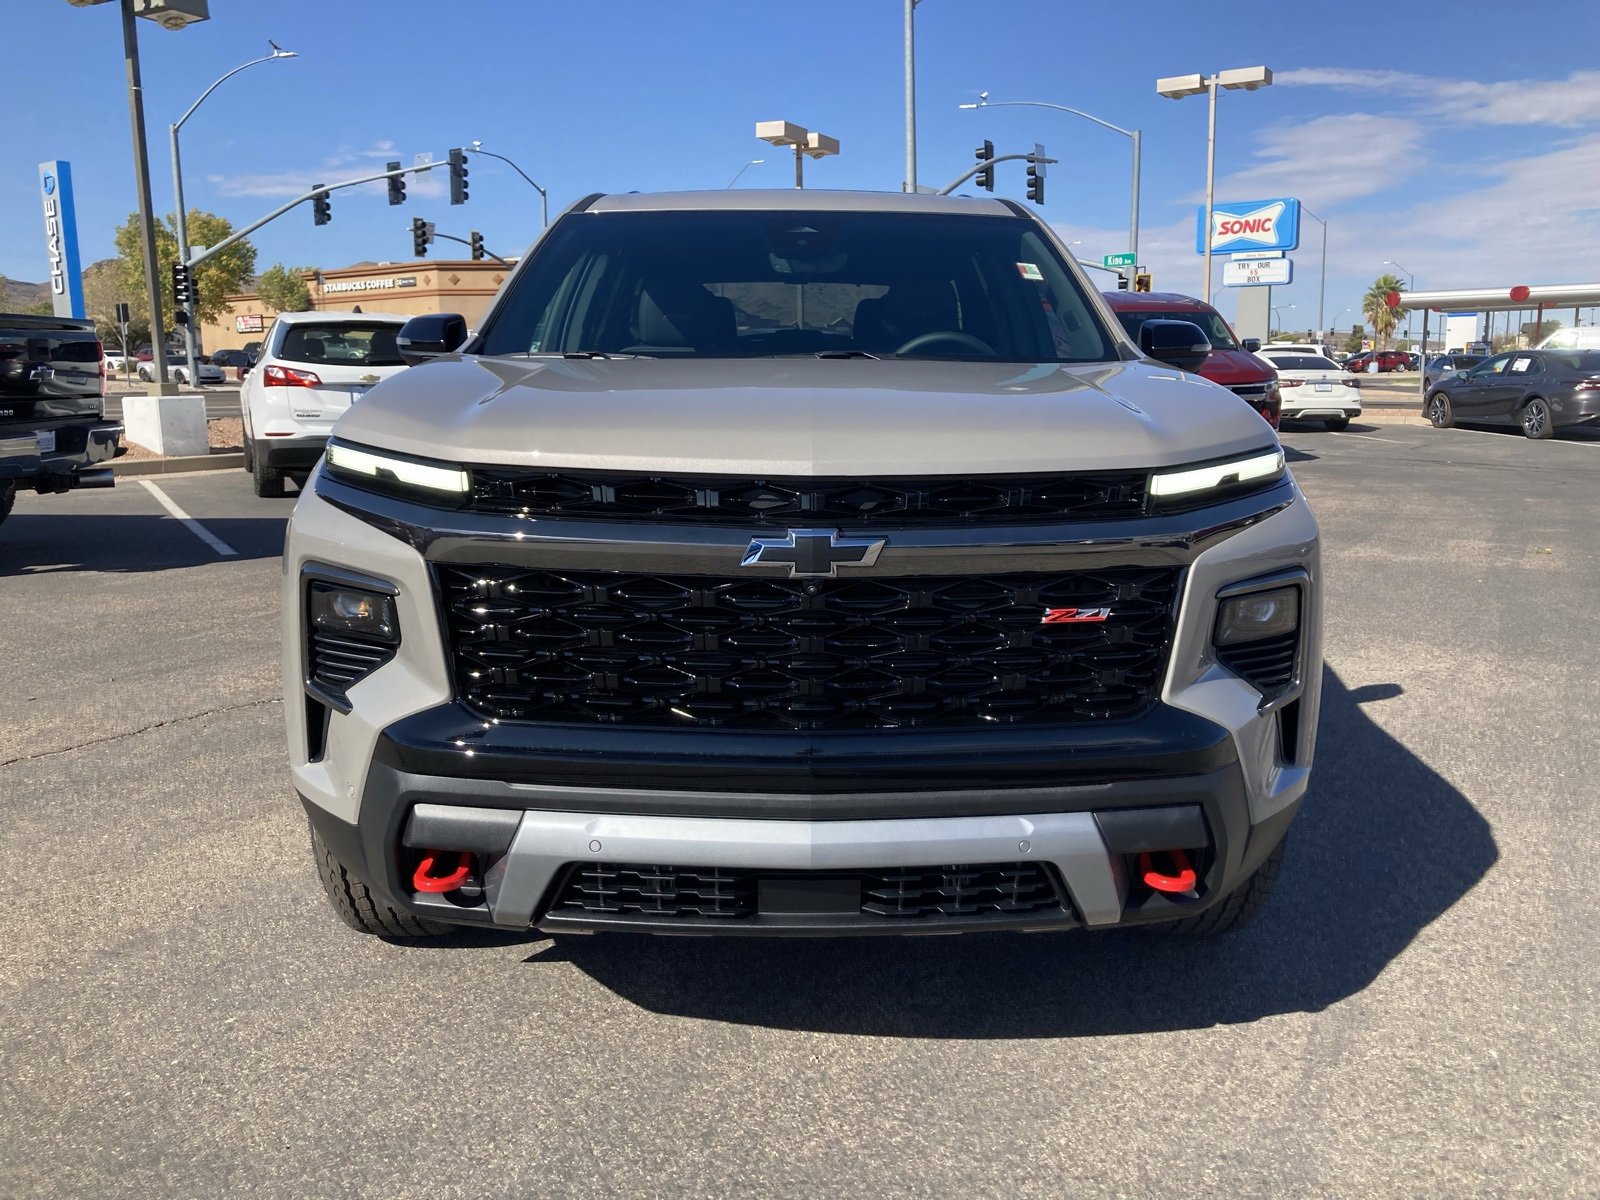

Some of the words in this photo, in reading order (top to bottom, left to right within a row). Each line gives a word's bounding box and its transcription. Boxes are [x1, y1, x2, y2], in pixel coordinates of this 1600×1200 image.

[1218, 218, 1273, 235] SONIC
[44, 199, 64, 294] CHASE
[1107, 256, 1123, 266] Kino
[323, 281, 366, 293] STARBUCKS
[366, 279, 395, 290] COFFEE
[1040, 608, 1111, 623] Z71
